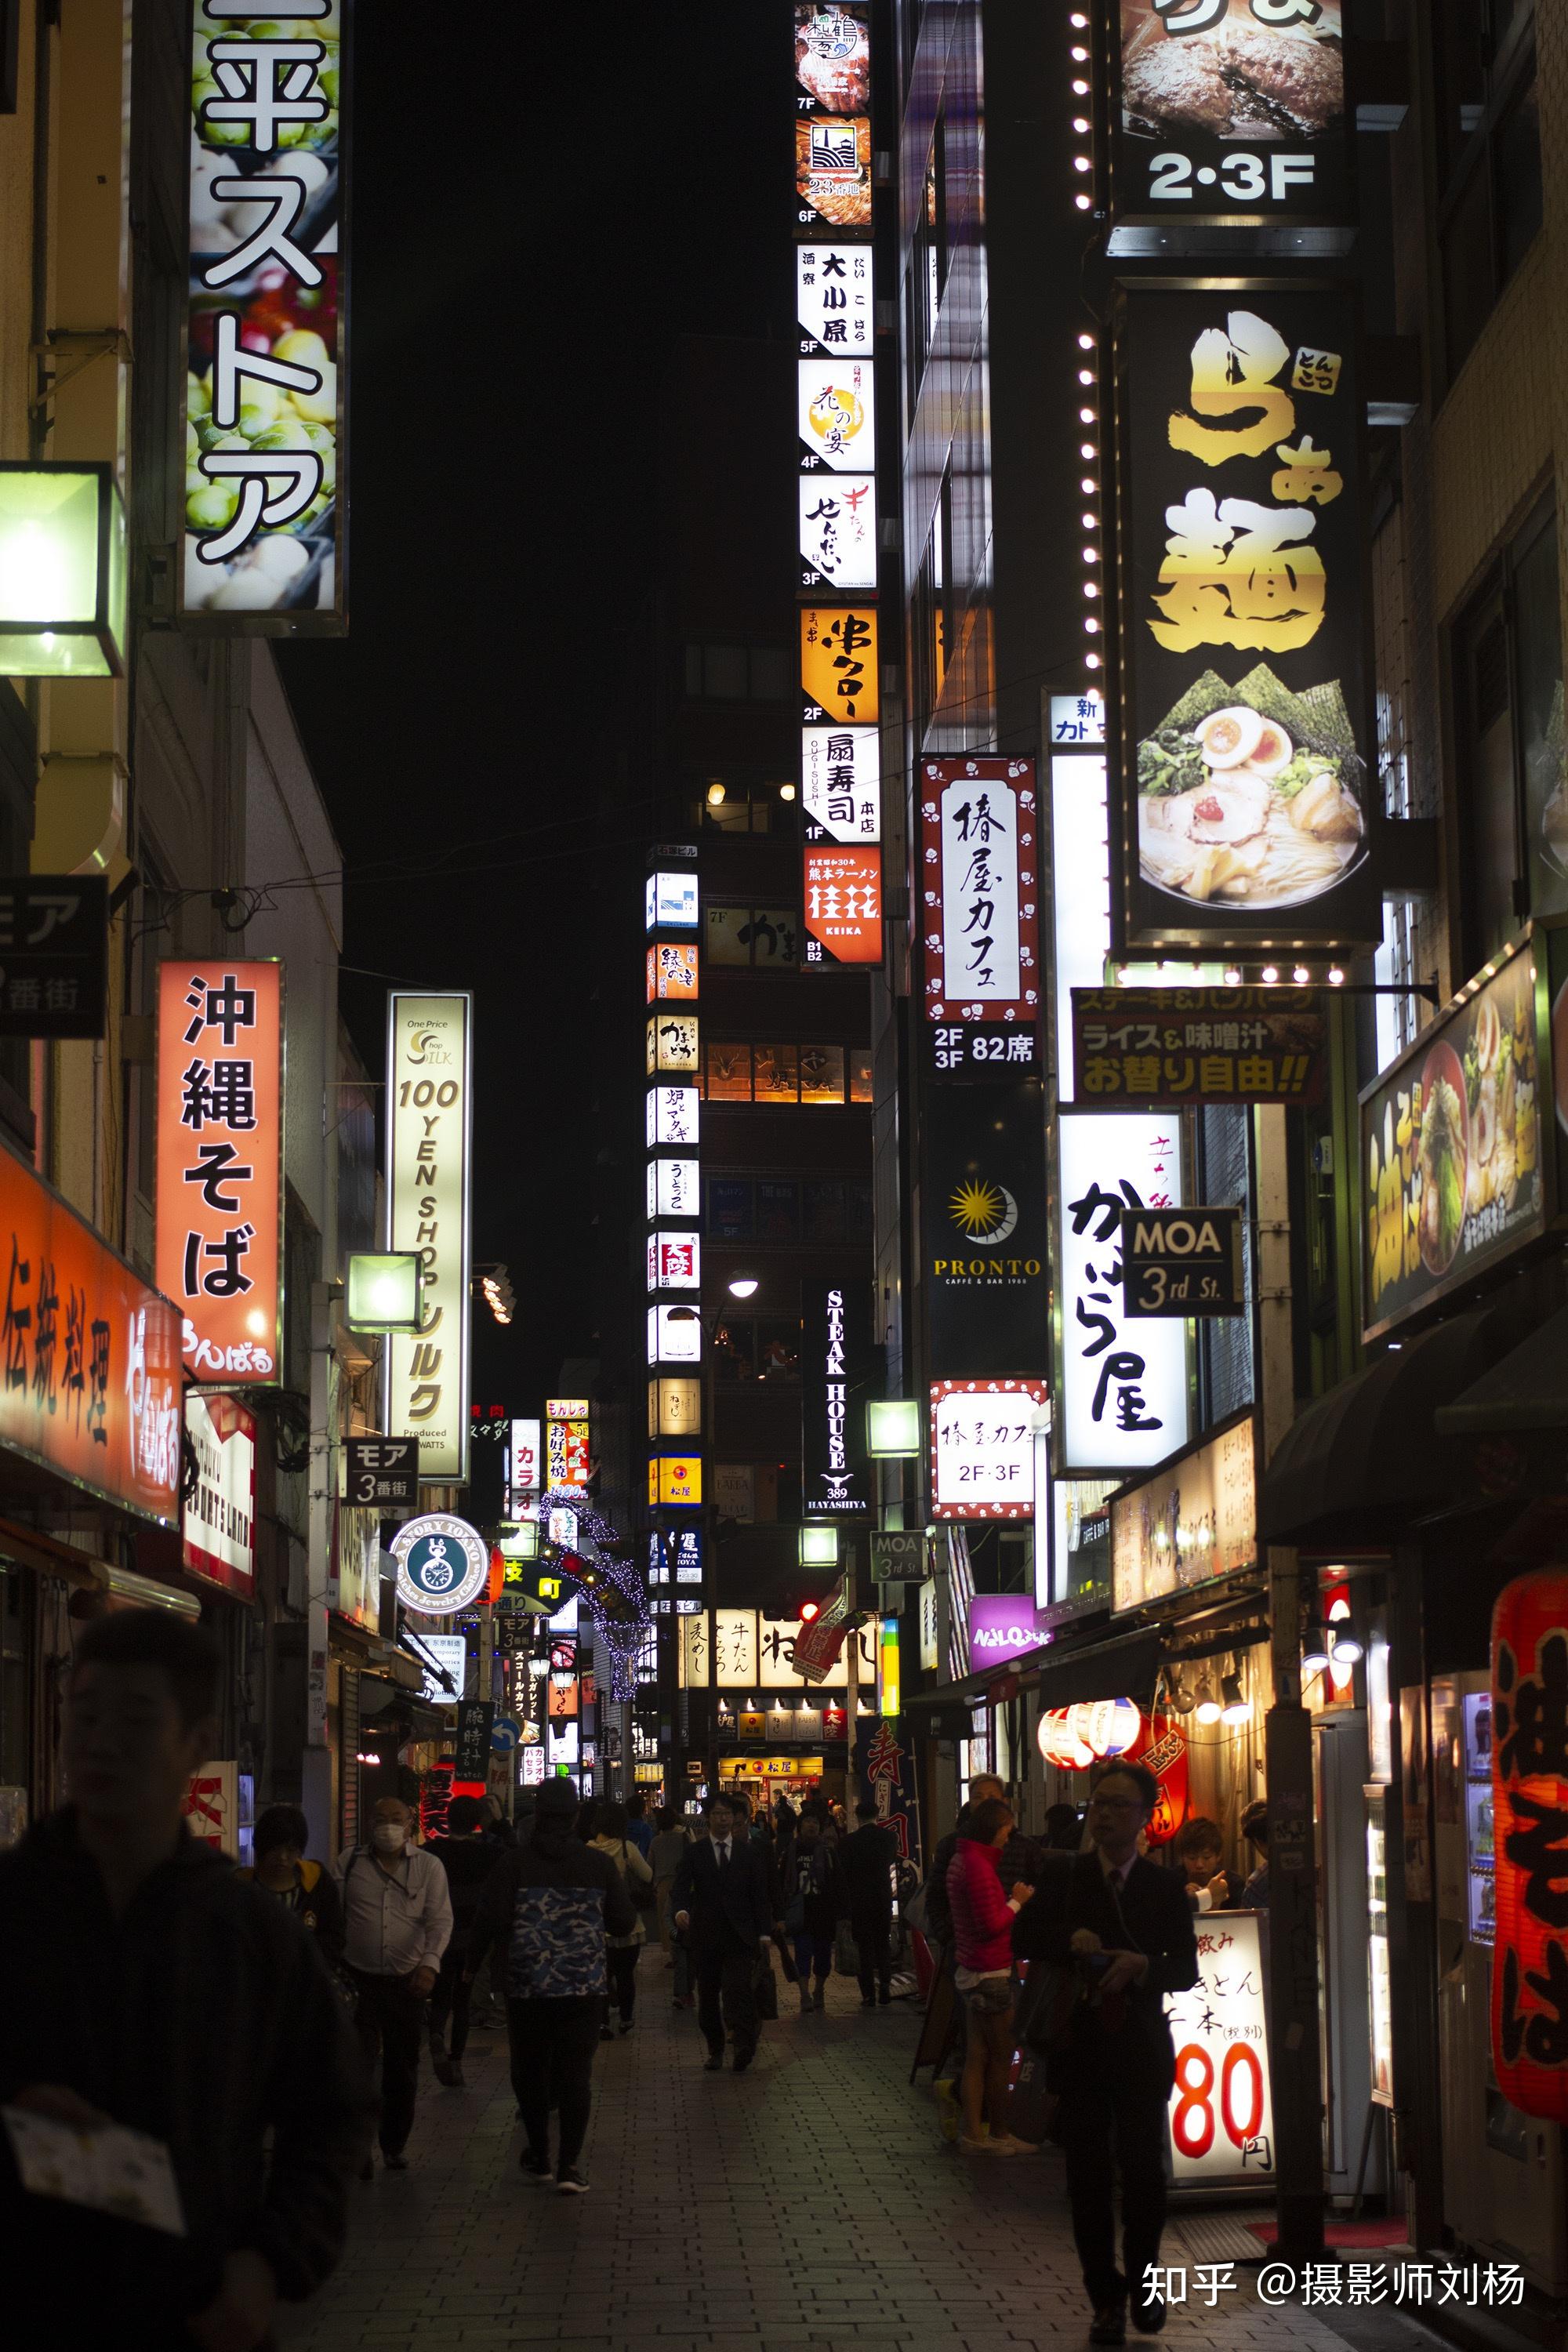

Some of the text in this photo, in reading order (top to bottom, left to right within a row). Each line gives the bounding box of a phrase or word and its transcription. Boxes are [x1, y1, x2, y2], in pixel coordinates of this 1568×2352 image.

[798, 98, 815, 109] 7F
[798, 210, 816, 223] 6F
[800, 340, 818, 353] 5F
[812, 386, 851, 455] 花の宴
[801, 456, 819, 468] 4F
[805, 498, 842, 574] せんだい
[802, 572, 820, 585] 3F
[804, 707, 822, 720] 2F
[826, 733, 855, 824] 扇寿司
[860, 801, 875, 833] 本店
[806, 827, 824, 840] 1F
[808, 867, 878, 880] 熊本ラーメン
[953, 793, 1006, 987] 椿屋カフェ
[808, 884, 880, 919] 桂花
[826, 927, 862, 935] KEIKA
[807, 942, 821, 951] B1
[807, 952, 822, 961] B2
[0, 965, 78, 1010] 番街
[935, 1029, 964, 1046] 2F
[972, 1035, 1034, 1062] 82席
[935, 1051, 964, 1069] 3F
[399, 1080, 460, 1108] 100
[665, 1089, 690, 1142] 炉とマタギ
[180, 974, 259, 1298] 沖縄そば
[415, 1116, 440, 1186] YEN
[1134, 1221, 1222, 1254] MOA
[934, 1260, 1041, 1276] PRONTO
[1138, 1267, 1221, 1310] 3rd St.
[826, 1290, 847, 1470] STEAK HOUSE
[548, 1403, 586, 1417] もんじゃ
[404, 1429, 447, 1438] Produced
[357, 1444, 408, 1468] モア
[419, 1440, 445, 1450] WATTS
[550, 1425, 567, 1479] お好み焼
[357, 1474, 407, 1502] 3番街
[670, 1486, 691, 1496] 松屋
[827, 1488, 848, 1499] 389
[808, 1501, 867, 1510] HAYASHIYA
[401, 1521, 445, 1547] STORY
[445, 1522, 481, 1562] TOKYO
[877, 1537, 917, 1552] MOA
[879, 1558, 902, 1578] 3rd
[419, 1594, 462, 1607] Jewelry
[459, 1563, 481, 1597] Clothes
[661, 1601, 701, 1613] 石ビル
[504, 1618, 530, 1630] モア
[690, 1621, 708, 1674] 麦めし
[731, 1621, 750, 1673] 牛たん
[761, 1625, 876, 1668] ねし
[768, 1761, 792, 1773] 松屋
[879, 1783, 888, 1815] にぎり
[1169, 1971, 1262, 2002] きとん
